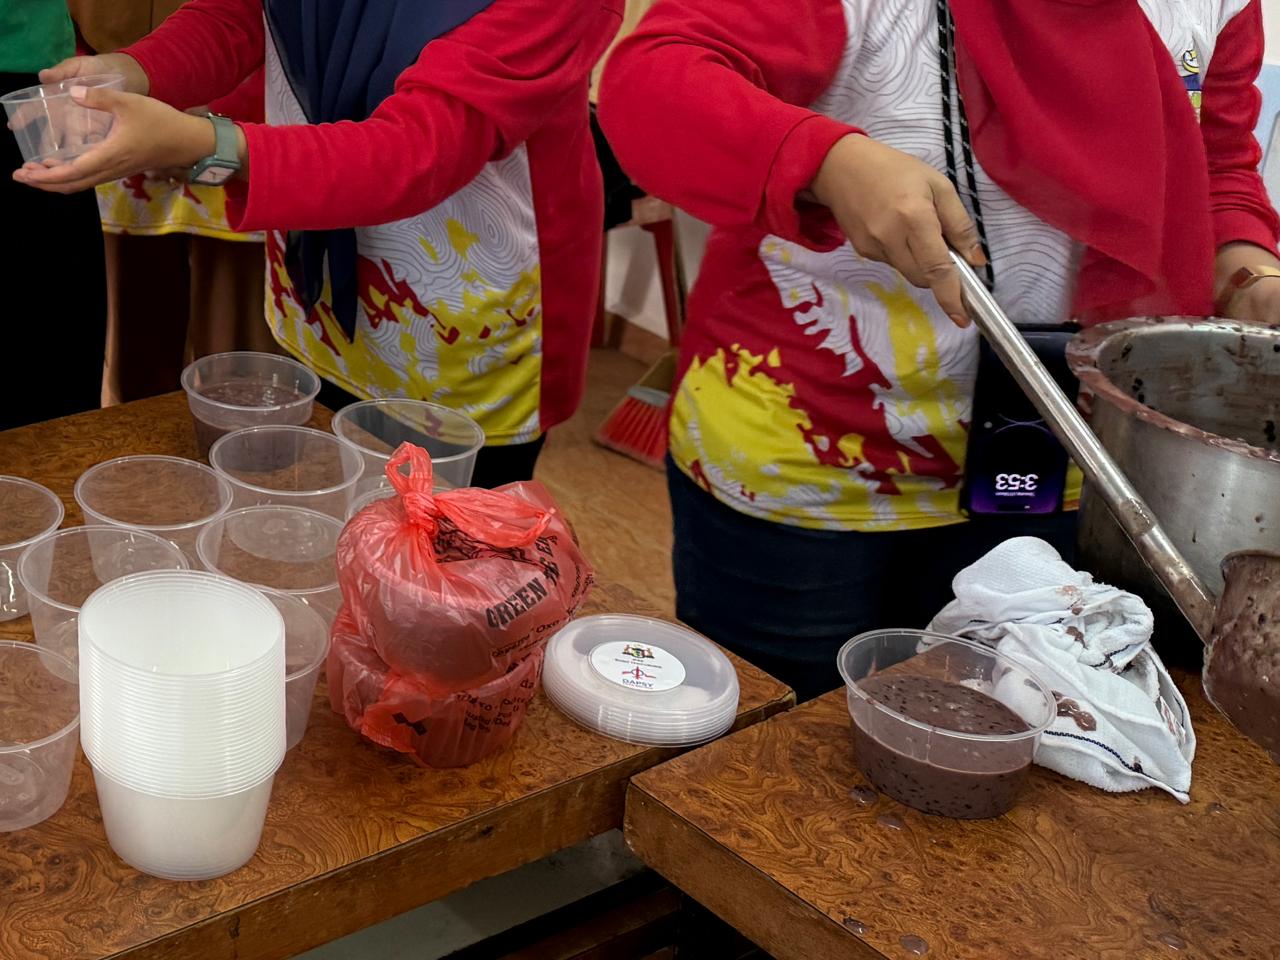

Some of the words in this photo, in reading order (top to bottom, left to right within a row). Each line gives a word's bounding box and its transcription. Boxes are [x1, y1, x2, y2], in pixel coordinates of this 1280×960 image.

[995, 473, 1039, 490] 3:53
[485, 577, 548, 629] GREEN
[622, 678, 655, 688] DAPSY
